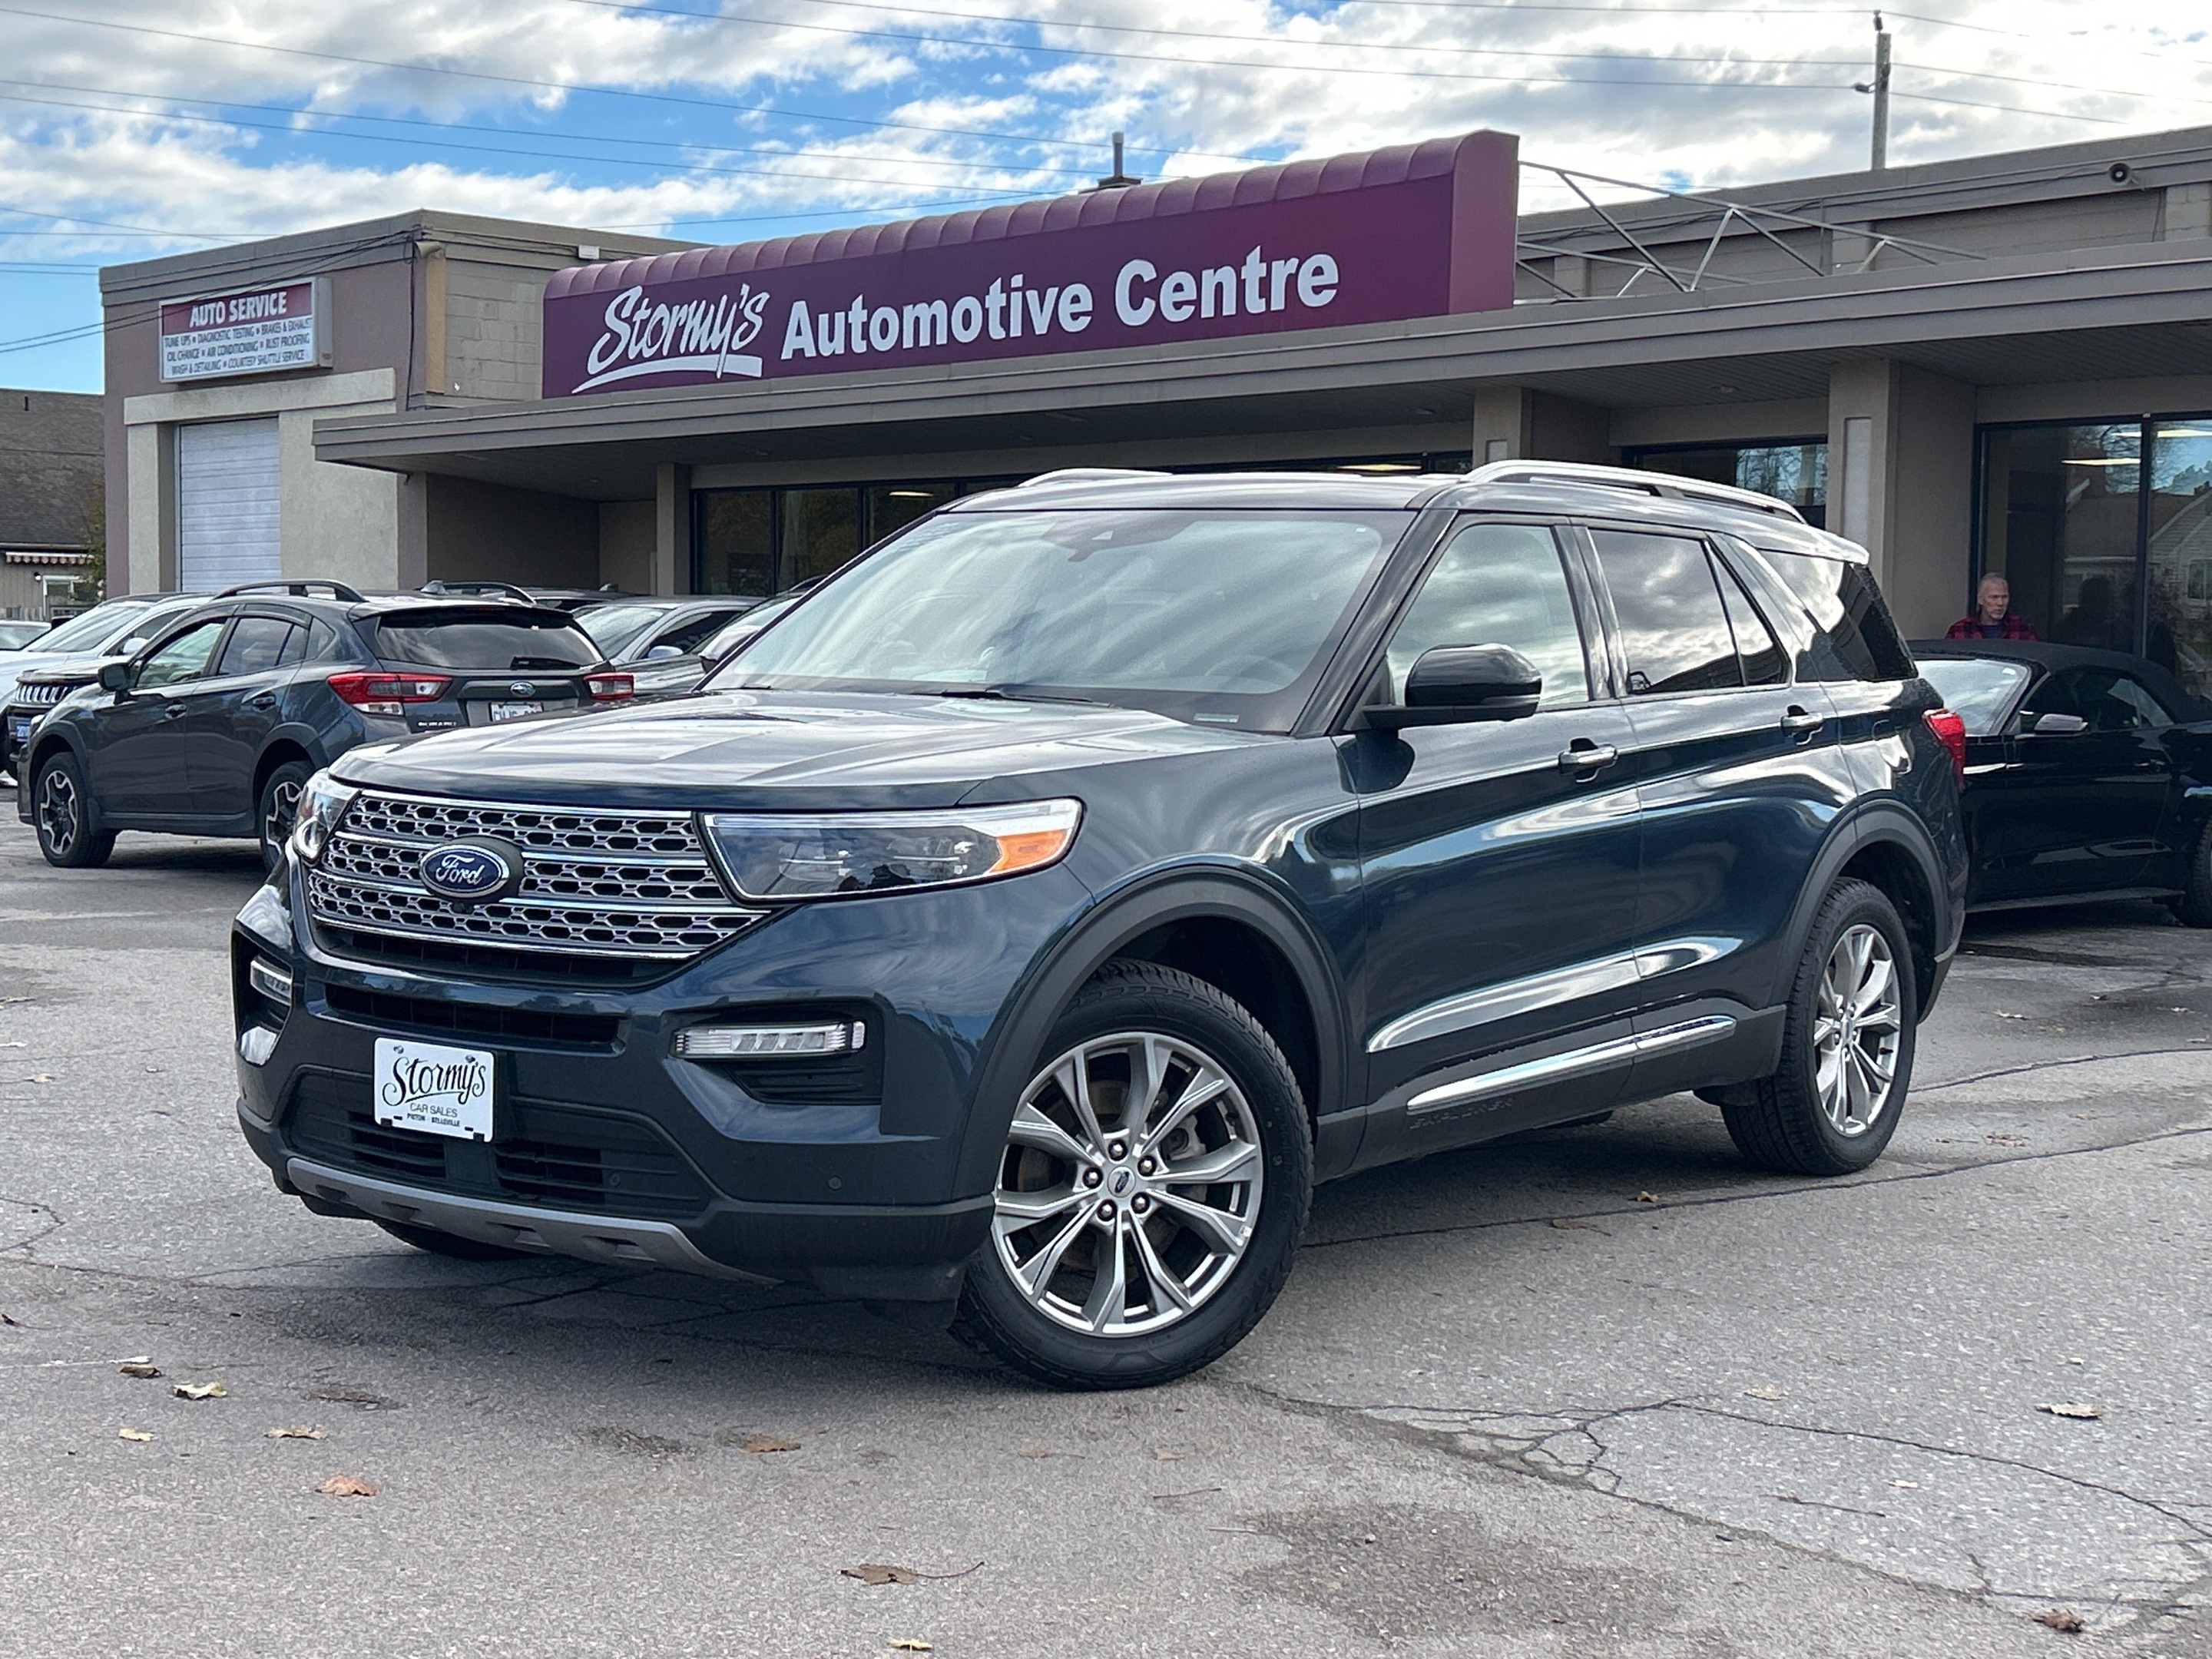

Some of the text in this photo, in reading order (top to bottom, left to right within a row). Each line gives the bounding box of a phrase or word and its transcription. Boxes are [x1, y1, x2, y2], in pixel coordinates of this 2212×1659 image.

[189, 292, 287, 327] AUTO SERVICE
[587, 245, 1339, 379] Stormy's Automotive Centre
[165, 336, 178, 348] TUNE
[180, 334, 191, 345] UPS
[197, 329, 230, 343] DIAGNOSTIC
[233, 326, 253, 339] TESTING
[261, 322, 280, 335] BRAKES
[288, 318, 312, 331] EXHAUST
[167, 333, 310, 361] OIL CHANGE AIR CONDITIONING RUST PROOFING
[171, 362, 188, 375] WASH
[194, 359, 221, 373] DETAILING
[257, 353, 280, 366] SHUTTLE
[282, 349, 304, 362] SERVICE
[435, 854, 485, 886] Ford
[382, 1056, 486, 1107] Stormy's
[410, 1102, 459, 1118] CAR SALES
